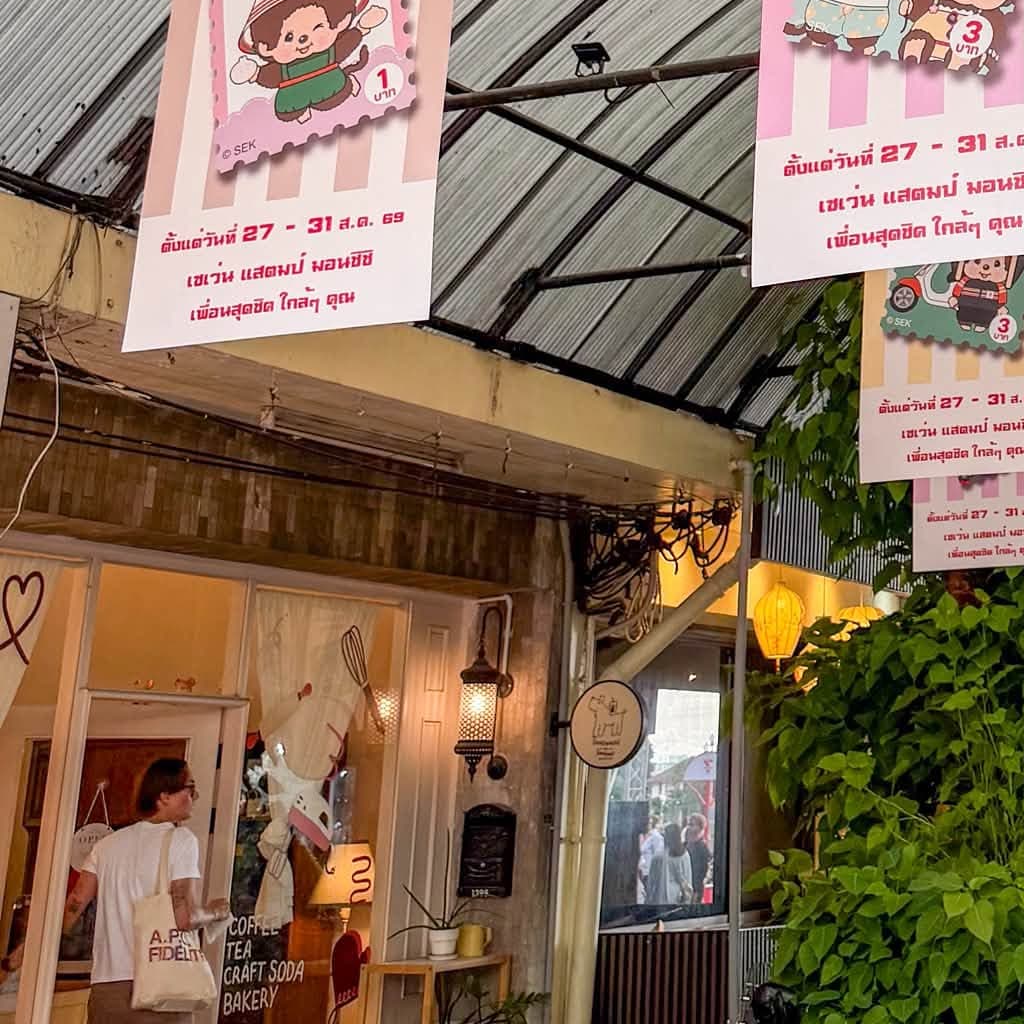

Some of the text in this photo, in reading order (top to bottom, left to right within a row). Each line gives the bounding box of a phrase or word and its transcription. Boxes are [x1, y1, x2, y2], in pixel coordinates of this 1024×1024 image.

[962, 20, 983, 44] 3
[956, 43, 979, 55] บาท
[376, 68, 388, 89] 1
[374, 87, 397, 101] บาท
[234, 139, 257, 156] SEK
[783, 144, 873, 177] ตั้งแต่วันที่
[880, 142, 917, 164] 27
[957, 134, 986, 153] 31
[818, 184, 875, 213] เซเว่น
[883, 173, 959, 205] แสตมป์
[160, 224, 238, 254] ตั้งแต่วันที่
[242, 223, 274, 243] 27
[307, 215, 332, 234] 31
[382, 212, 404, 225] 69
[988, 215, 1023, 236] คุณ
[186, 249, 373, 288] เซเว่น แสตมป์ มอนชิชิ
[325, 292, 355, 311] คุณ
[894, 317, 912, 328] SEK
[997, 318, 1010, 334] 3
[939, 396, 963, 409] 27
[987, 393, 1006, 405] 31
[226, 939, 252, 960] TEA
[223, 959, 305, 985] CRAFT SODA
[223, 984, 279, 1016] BAKERY
